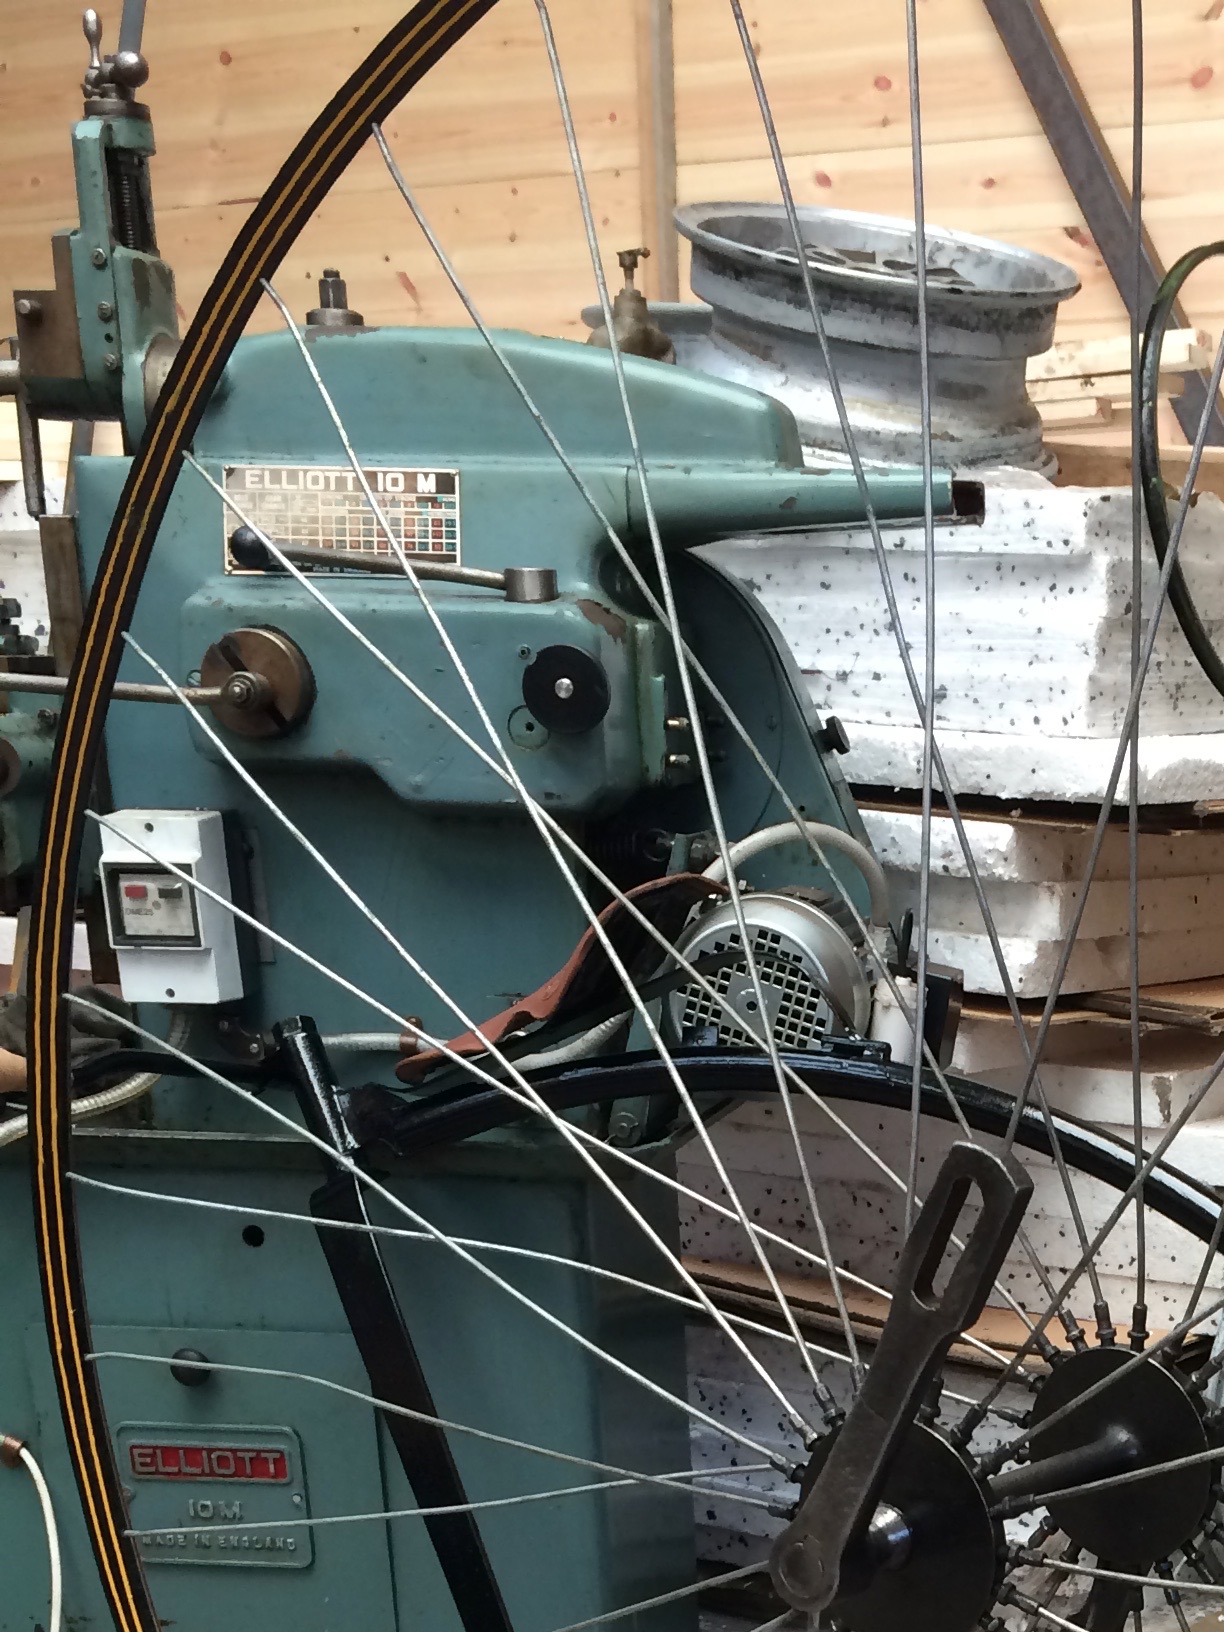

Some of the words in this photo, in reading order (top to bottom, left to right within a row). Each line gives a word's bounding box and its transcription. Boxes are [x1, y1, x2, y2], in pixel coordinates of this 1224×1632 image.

[245, 469, 357, 491] ELLIOTT
[377, 472, 405, 492] 10
[416, 473, 437, 494] M
[133, 1447, 281, 1477] ELLIOTT
[142, 1532, 188, 1547] MADE
[194, 1533, 211, 1548] IN
[217, 1535, 297, 1551] ENGLAND
